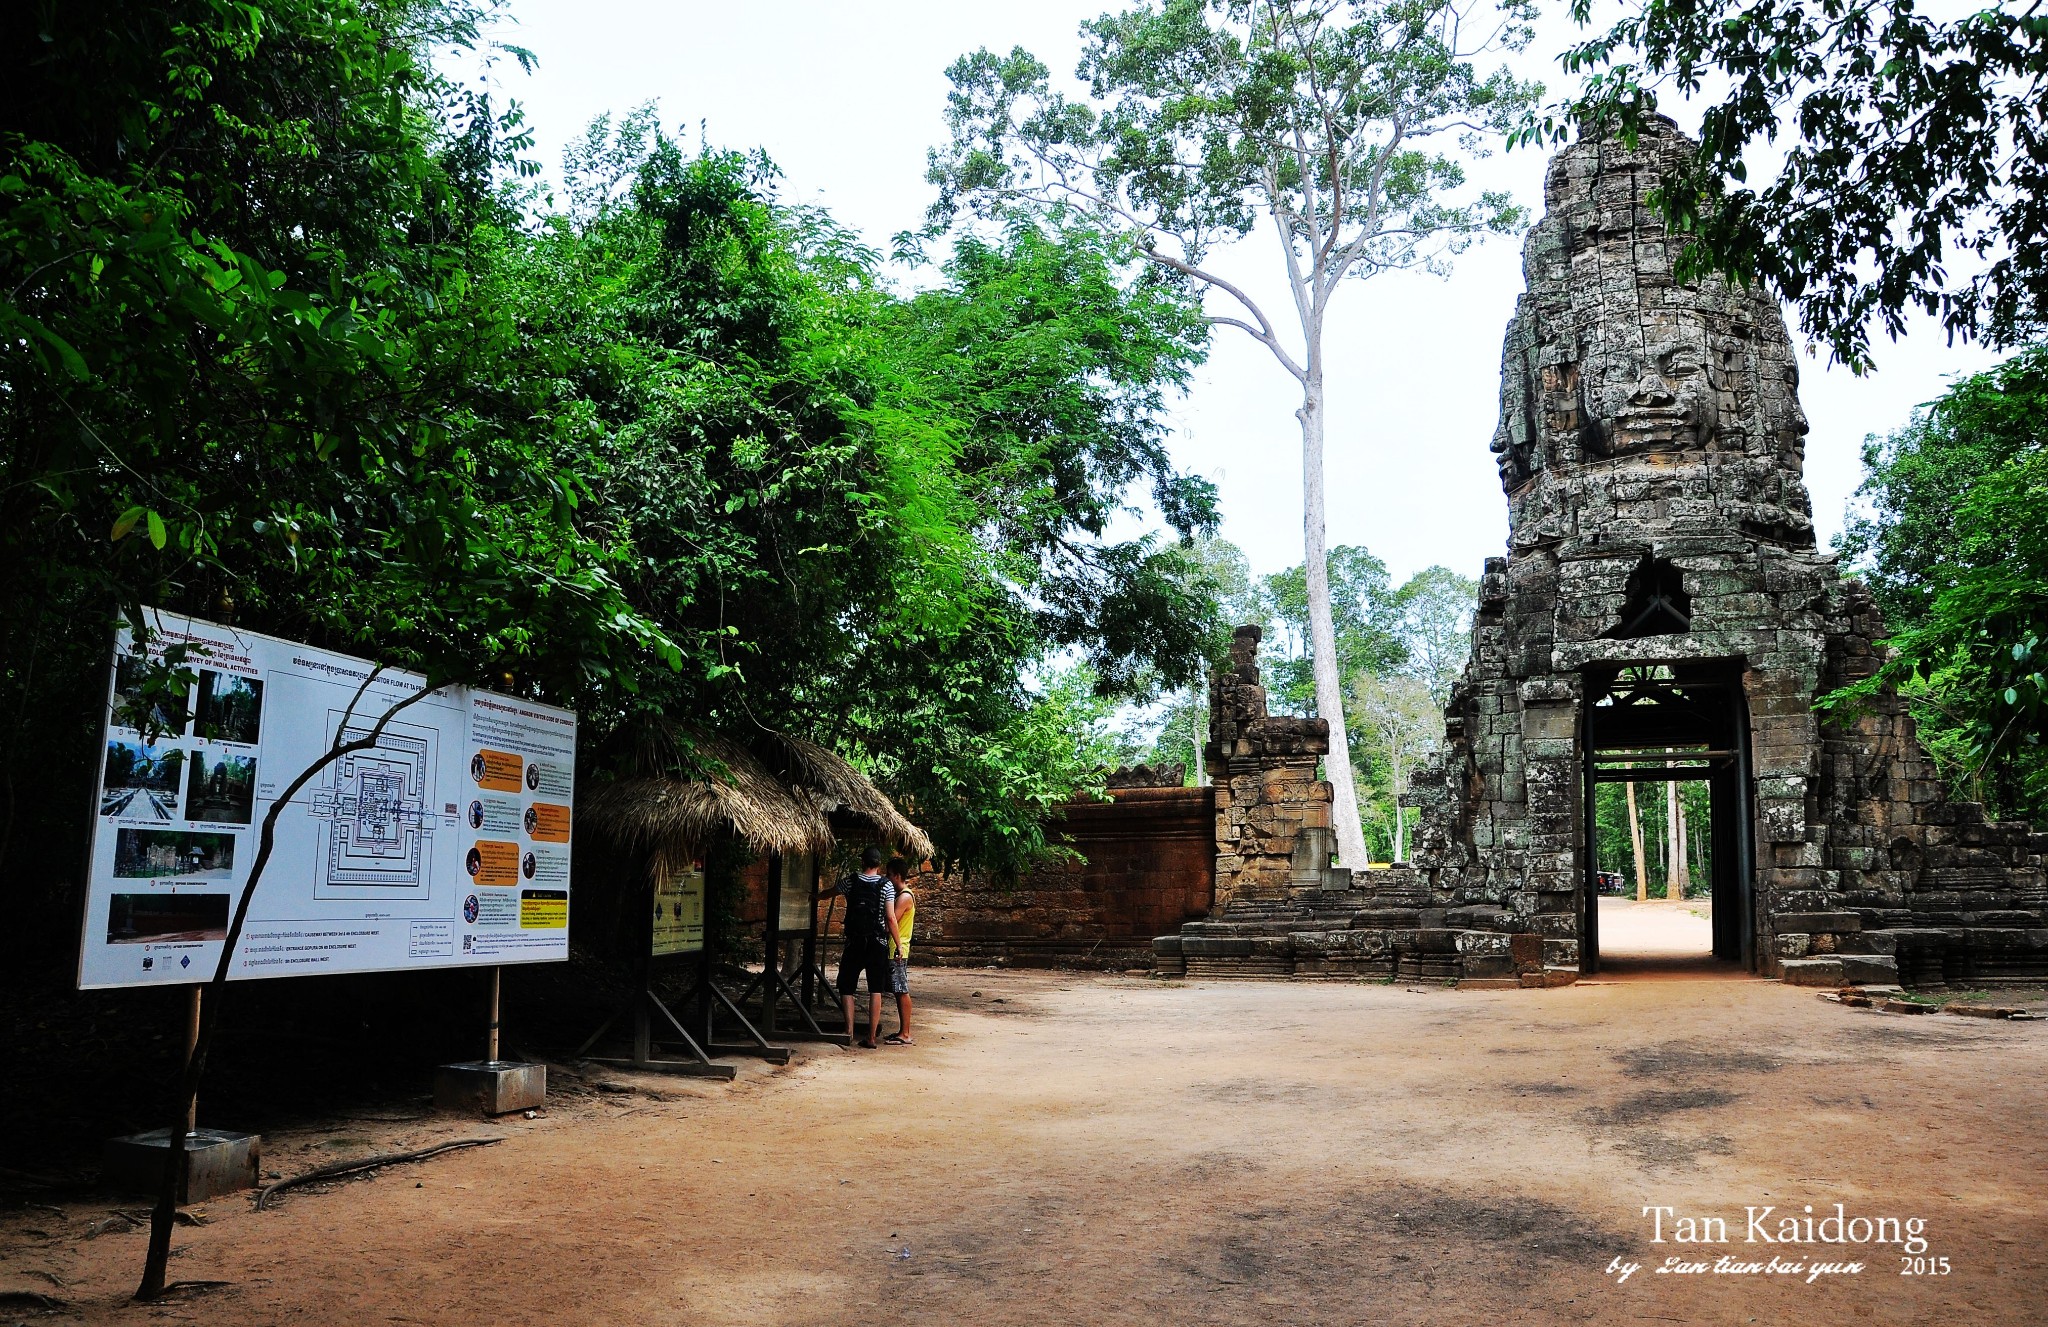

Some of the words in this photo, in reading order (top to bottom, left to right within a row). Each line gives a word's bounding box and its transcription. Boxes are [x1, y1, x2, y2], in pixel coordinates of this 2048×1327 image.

[230, 664, 258, 675] ACTIVITIES
[390, 679, 403, 688] FLOW
[409, 683, 416, 691] TA
